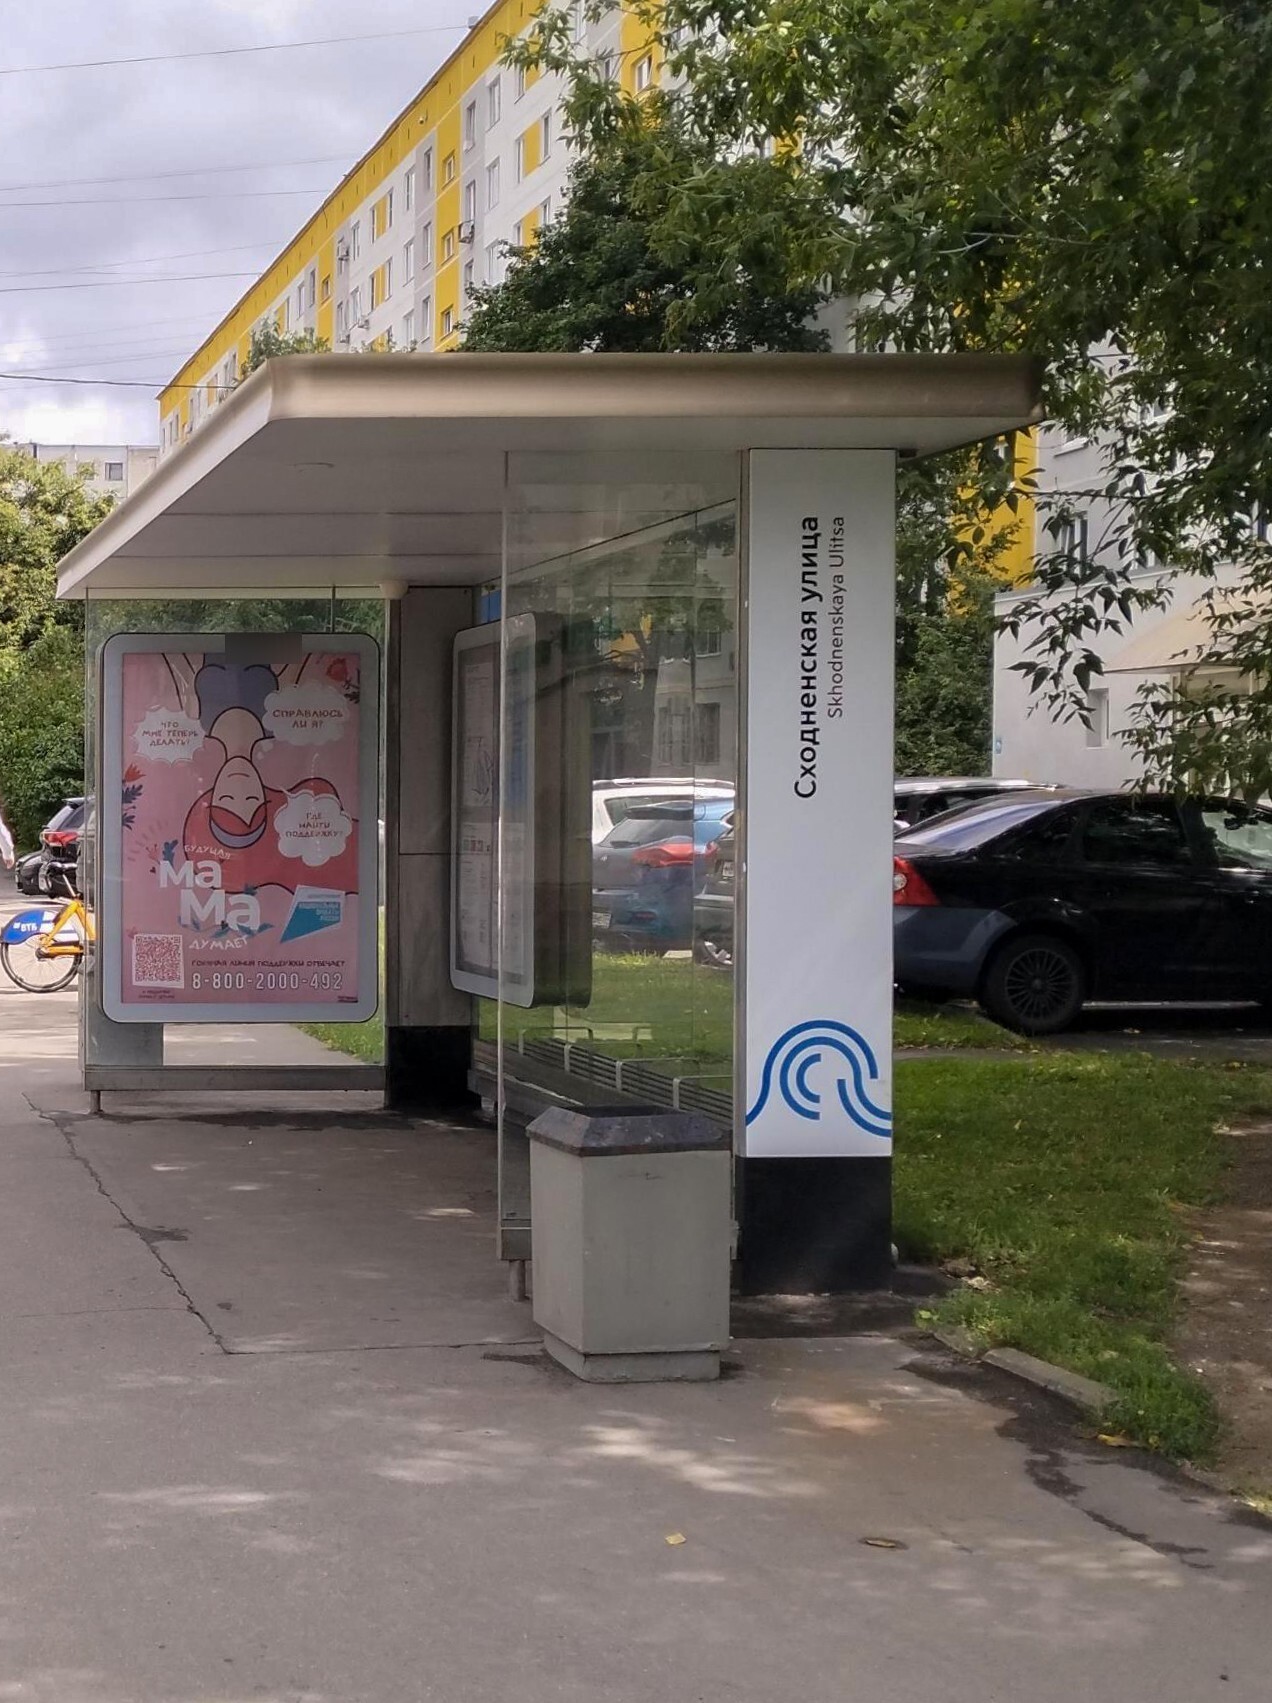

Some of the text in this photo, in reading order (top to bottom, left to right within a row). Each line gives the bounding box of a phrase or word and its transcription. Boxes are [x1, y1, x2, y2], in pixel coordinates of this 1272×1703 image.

[827, 516, 847, 719] Skhodnenskaya Ulitsa
[794, 516, 822, 799] Сходненская улица
[272, 709, 343, 718] СПРАВЛЮСЬ
[292, 720, 307, 728] ЛИ
[20, 922, 38, 932] ВТБ
[189, 935, 249, 950] ДУМАЕТ
[191, 972, 343, 990] 8-800-2000-492
